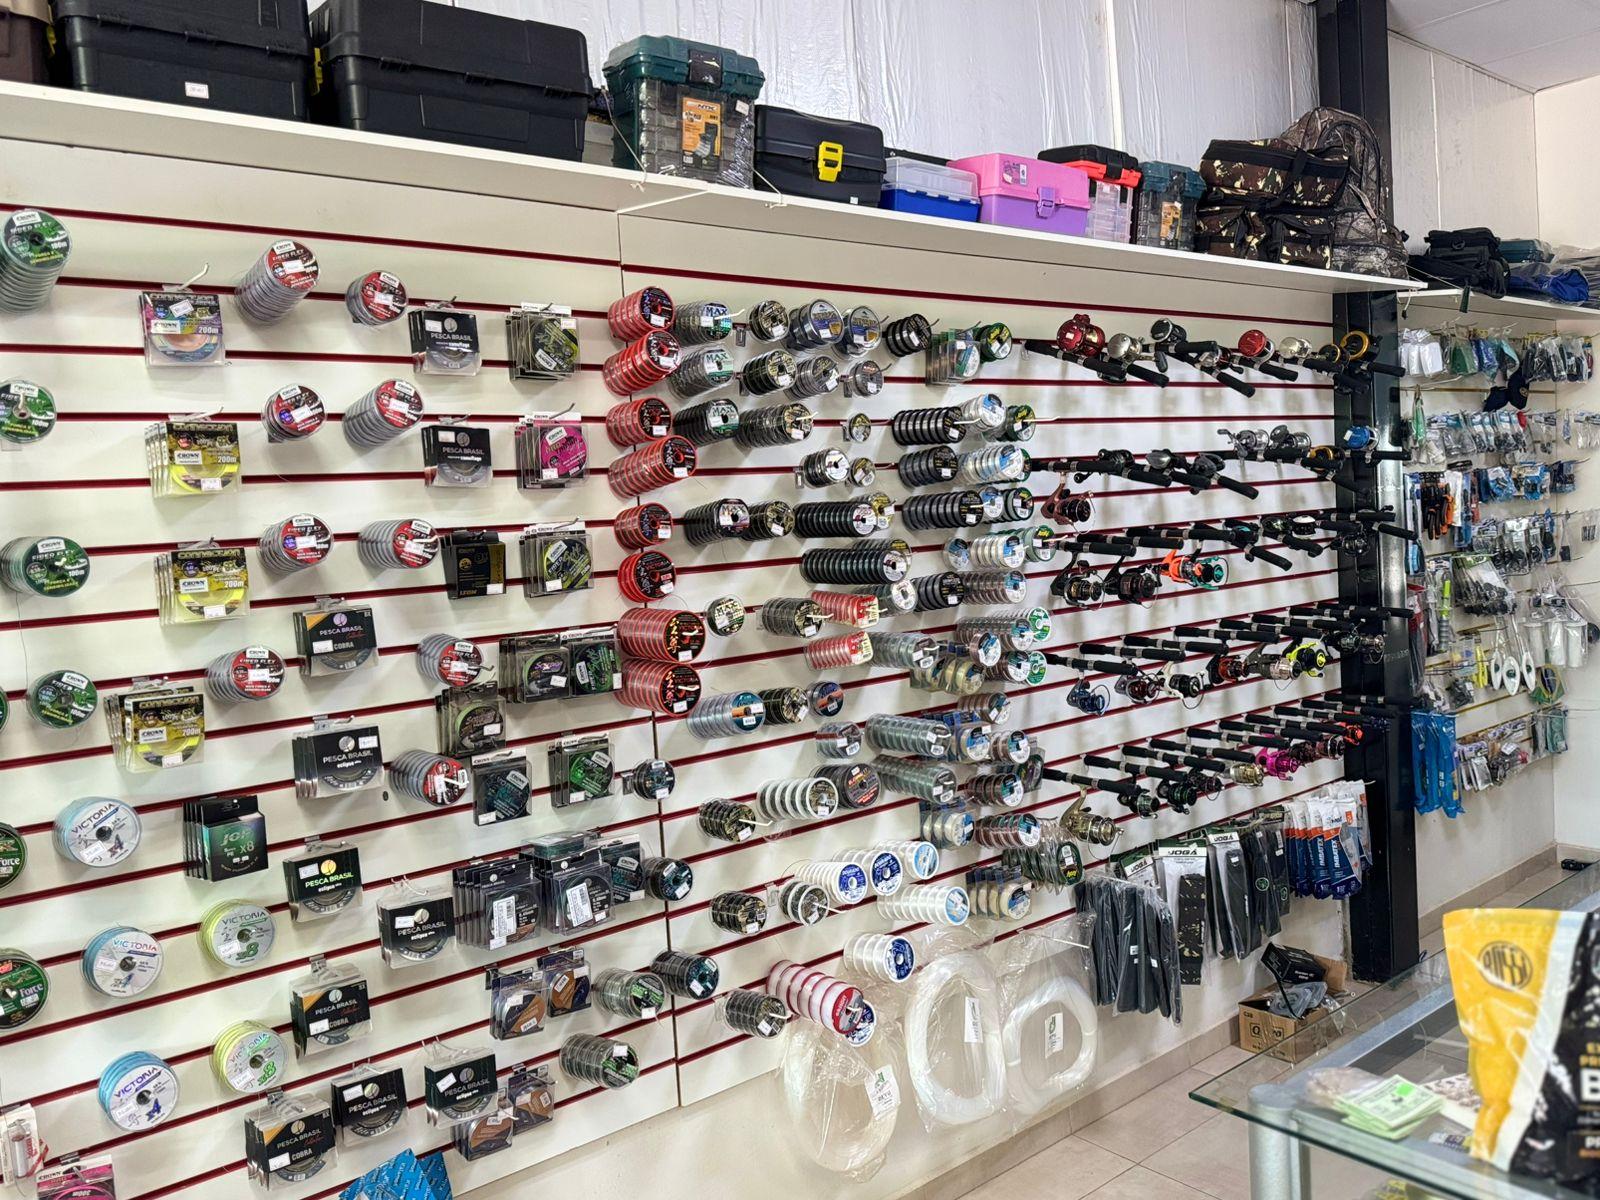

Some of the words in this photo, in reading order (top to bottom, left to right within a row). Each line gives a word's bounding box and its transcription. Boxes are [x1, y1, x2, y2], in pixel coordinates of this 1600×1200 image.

[705, 306, 727, 316] MAX
[198, 326, 219, 334] 200m
[431, 332, 451, 340] PESCA
[706, 352, 728, 361] MAX
[712, 406, 735, 416] MAX
[41, 541, 61, 549] CROWN
[319, 627, 341, 636] PESCA
[341, 625, 363, 633] BRASIL
[334, 642, 354, 650] COBRA
[141, 729, 164, 738] CROWN
[323, 752, 348, 763] PESCA
[348, 750, 373, 760] BRASIL
[72, 804, 115, 833] VICTORIA
[305, 877, 329, 888] PESCA
[329, 872, 354, 883] BRASIL
[222, 911, 267, 926] VICTORIA
[397, 925, 421, 937] PESCA
[422, 921, 447, 932] BRASIL
[113, 938, 158, 952] VICTORIA
[19, 983, 44, 997] Force
[315, 1005, 336, 1016] PESCA
[329, 1017, 349, 1029] COBRA
[114, 1066, 158, 1098] VICTORIA
[445, 1086, 466, 1098] PESCA
[467, 1079, 490, 1090] BRASIL
[349, 1100, 373, 1114] PESCA
[373, 1095, 398, 1107] BRASIL
[277, 1137, 299, 1150] PESCA
[300, 1128, 322, 1141] BRASIL
[291, 1148, 313, 1161] COBRA
[39, 1171, 61, 1180] CROWN
